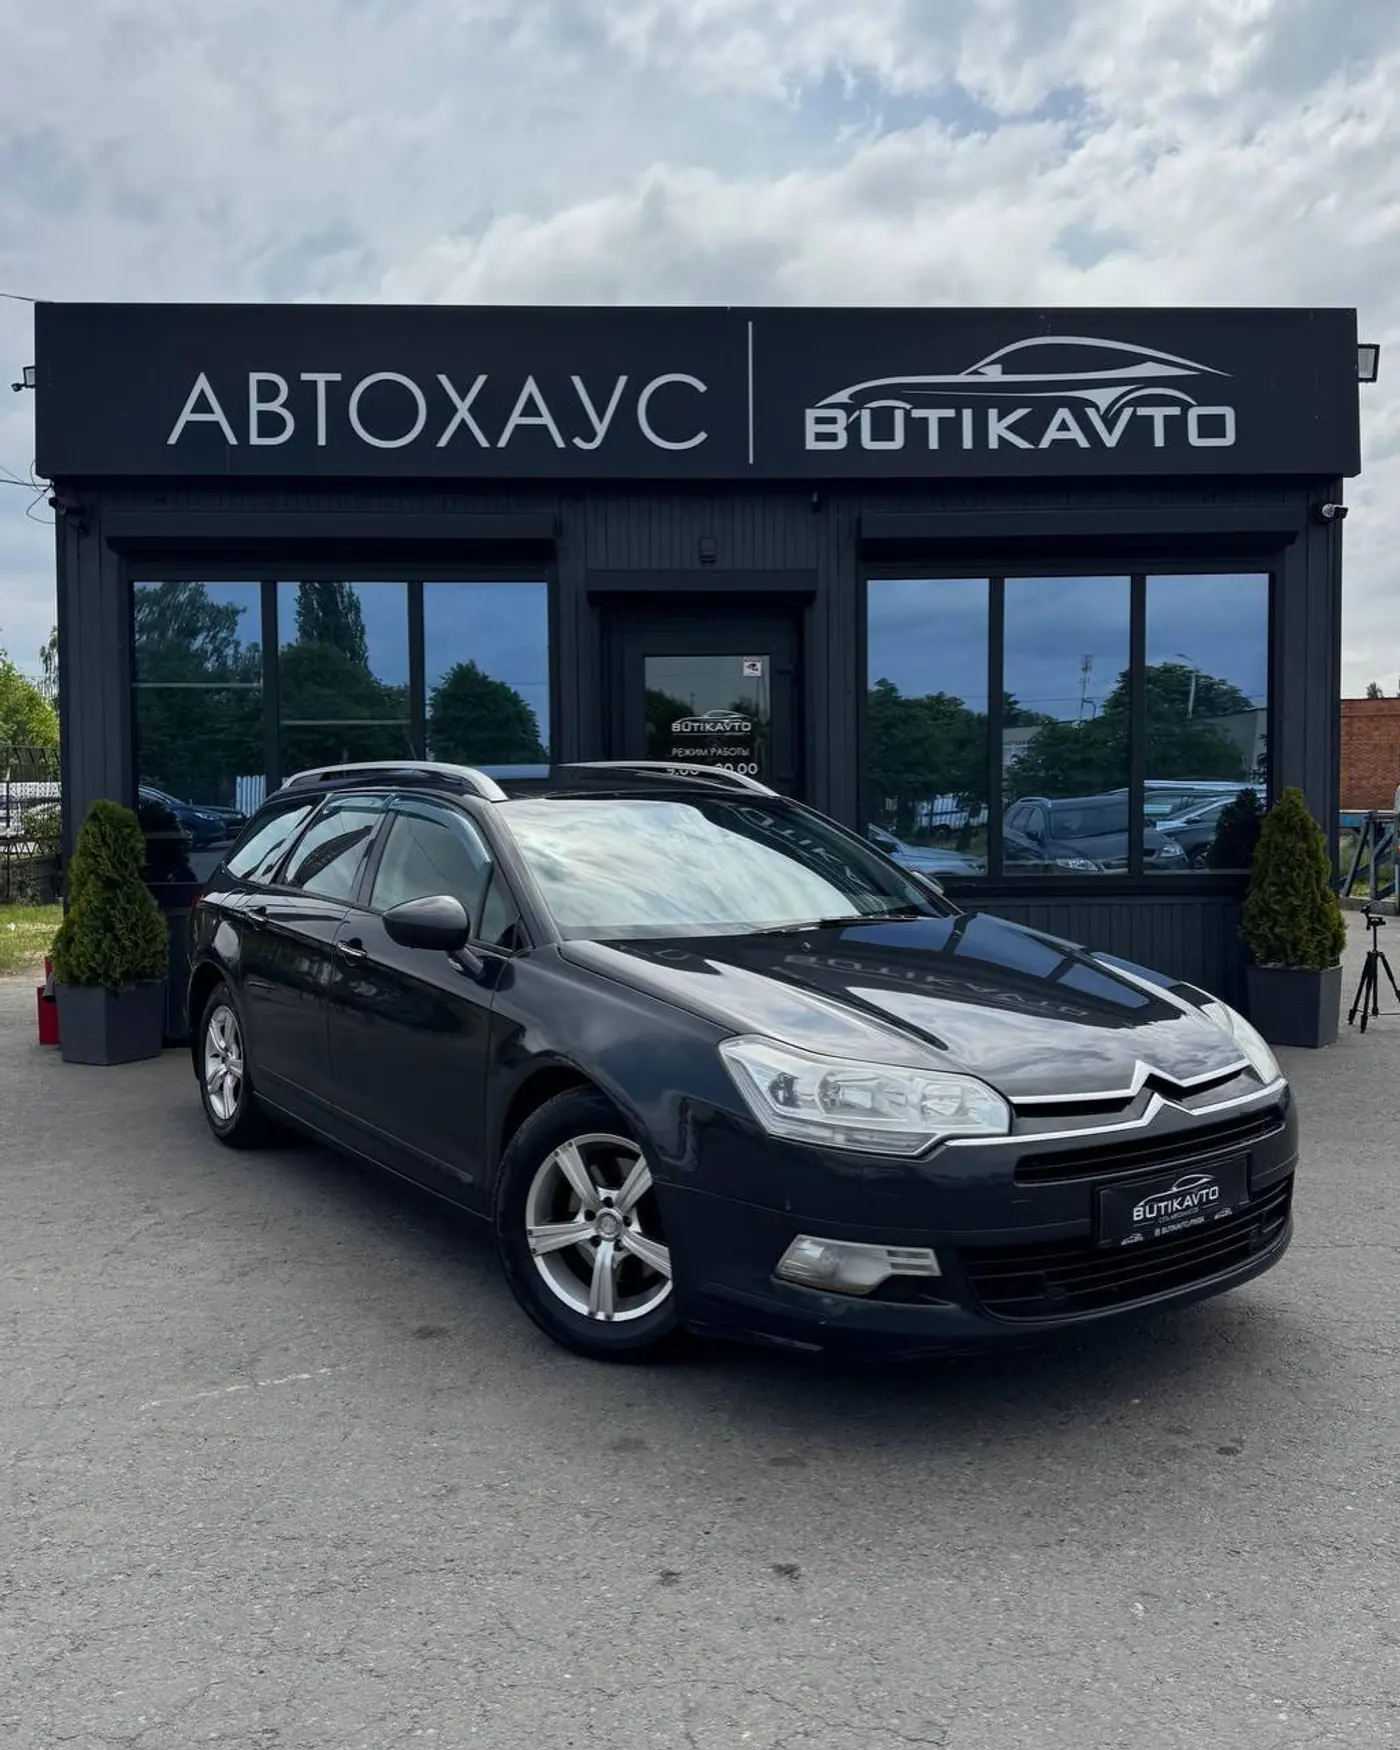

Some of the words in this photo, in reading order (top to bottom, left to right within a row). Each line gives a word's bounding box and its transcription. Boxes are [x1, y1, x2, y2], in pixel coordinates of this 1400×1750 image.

[166, 371, 709, 451] АВТОХАУС
[804, 405, 1236, 451] BUTIKAVTO
[671, 721, 752, 732] BUTIKAVTO
[671, 747, 708, 757] РЕЖИМ
[710, 747, 750, 757] РАБОТЫ
[1133, 1186, 1219, 1221] BUTIKAVTO
